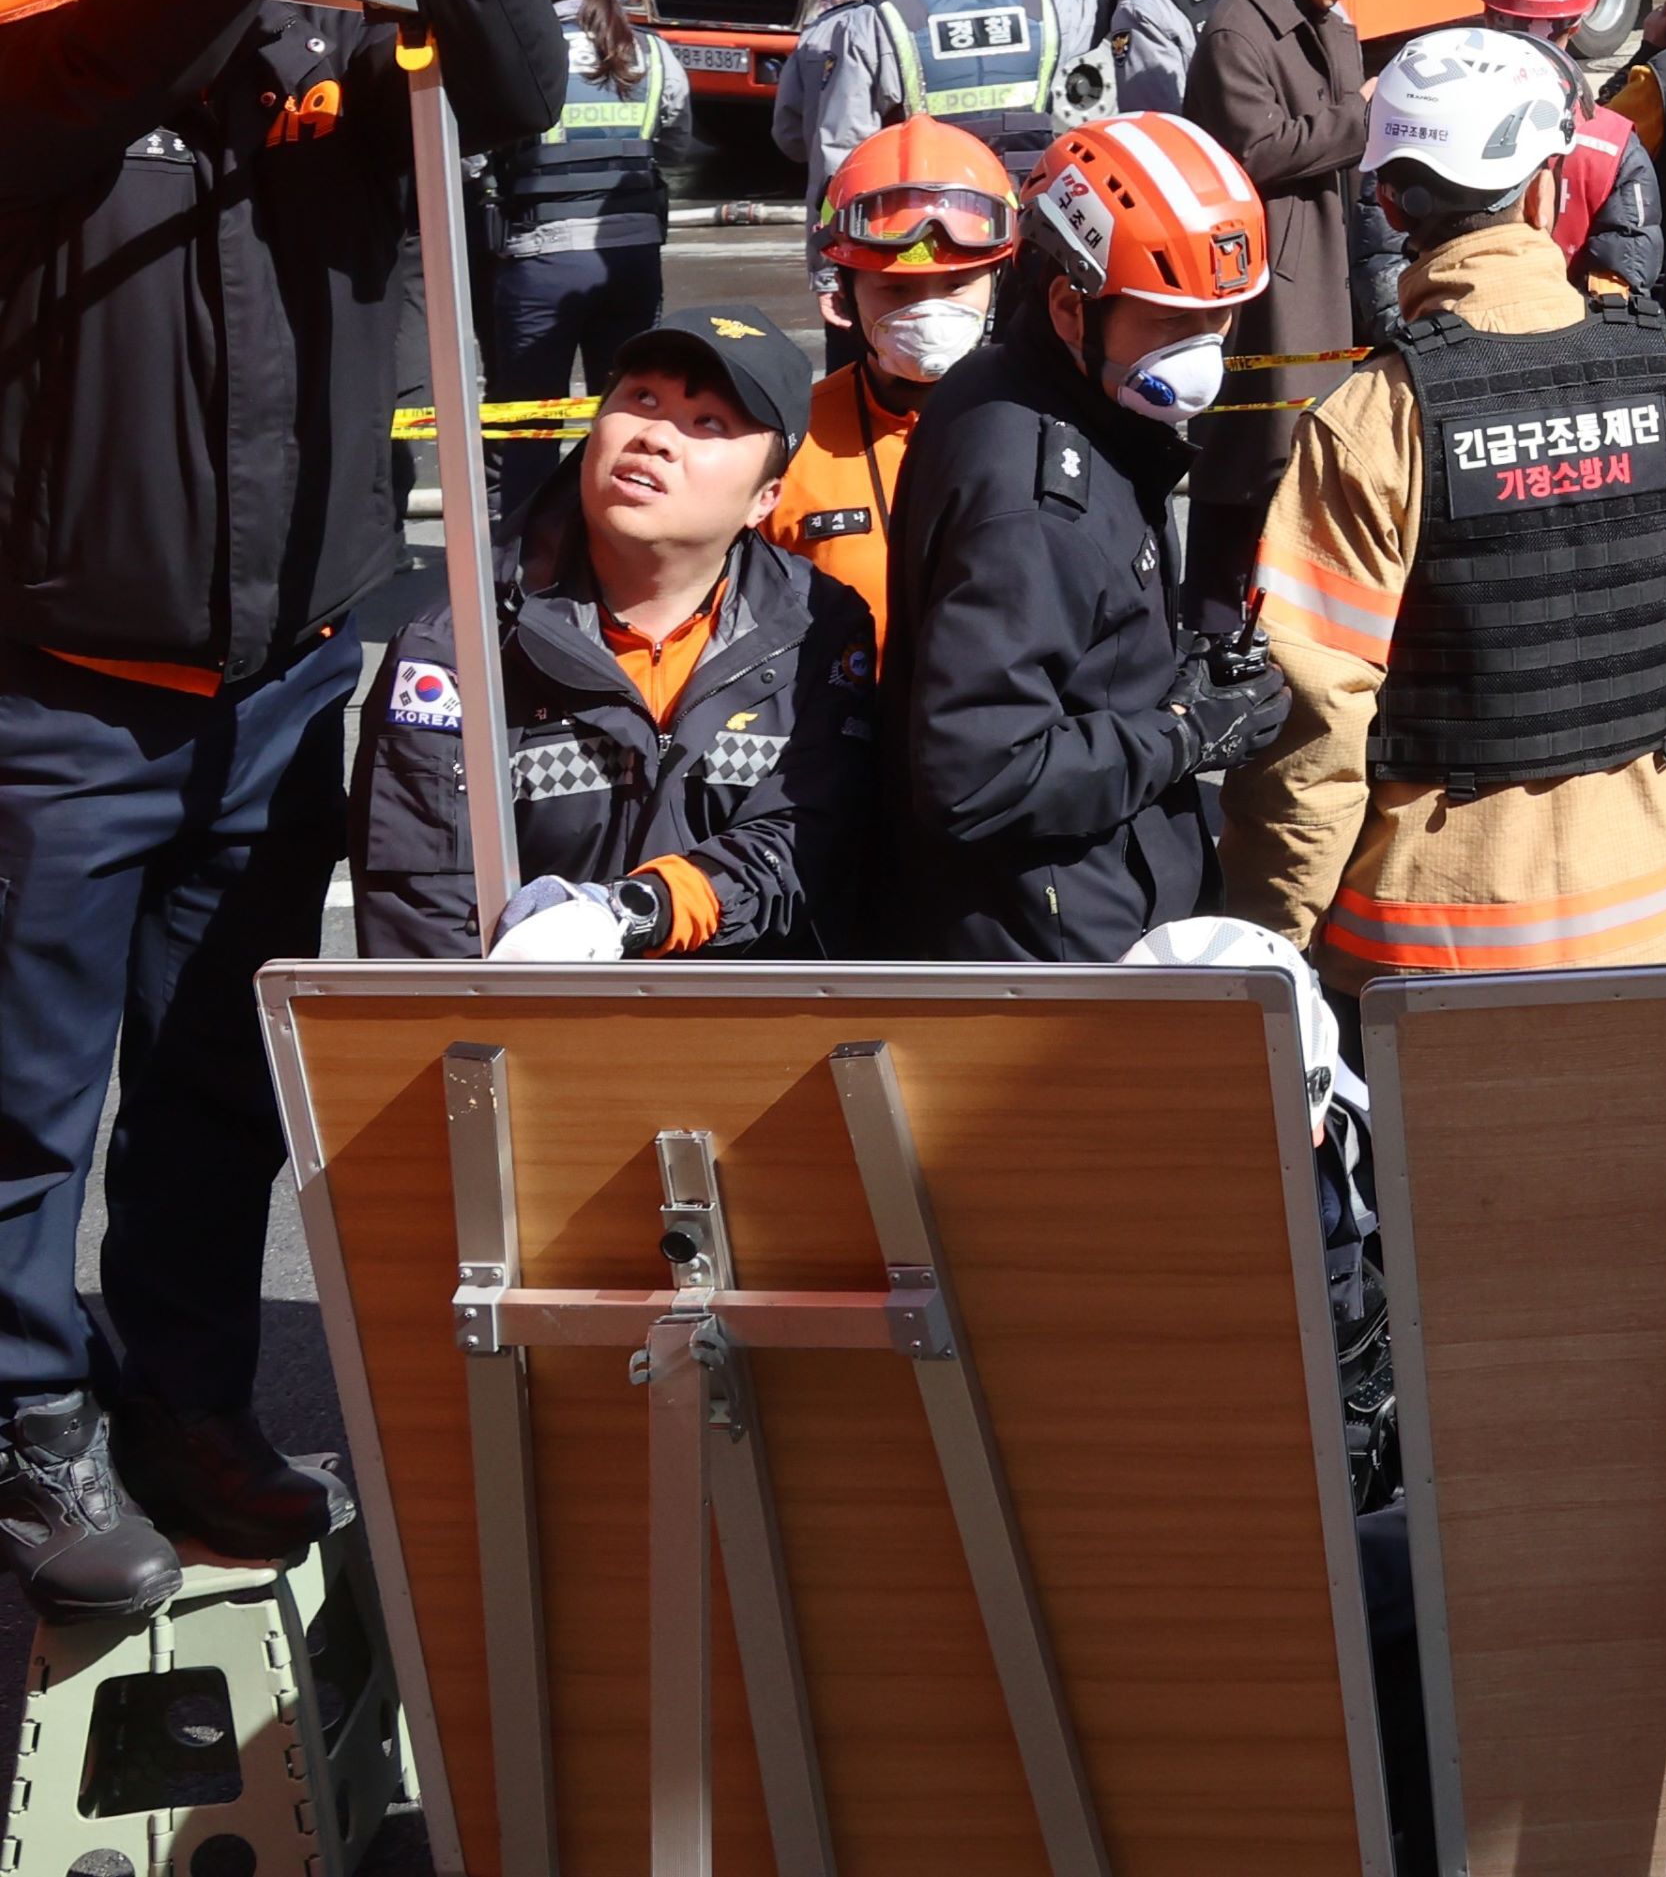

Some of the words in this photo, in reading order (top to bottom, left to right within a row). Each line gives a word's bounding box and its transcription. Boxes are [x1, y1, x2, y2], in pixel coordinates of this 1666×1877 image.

[944, 15, 1014, 49] 경찰
[568, 103, 637, 124] POLICE
[1385, 123, 1449, 142] 긴급구조통제단
[1062, 173, 1090, 198] 119
[1453, 404, 1661, 470] 긴급구조통제단
[1496, 453, 1632, 501] 기장소방서
[394, 710, 459, 728] KOREA
